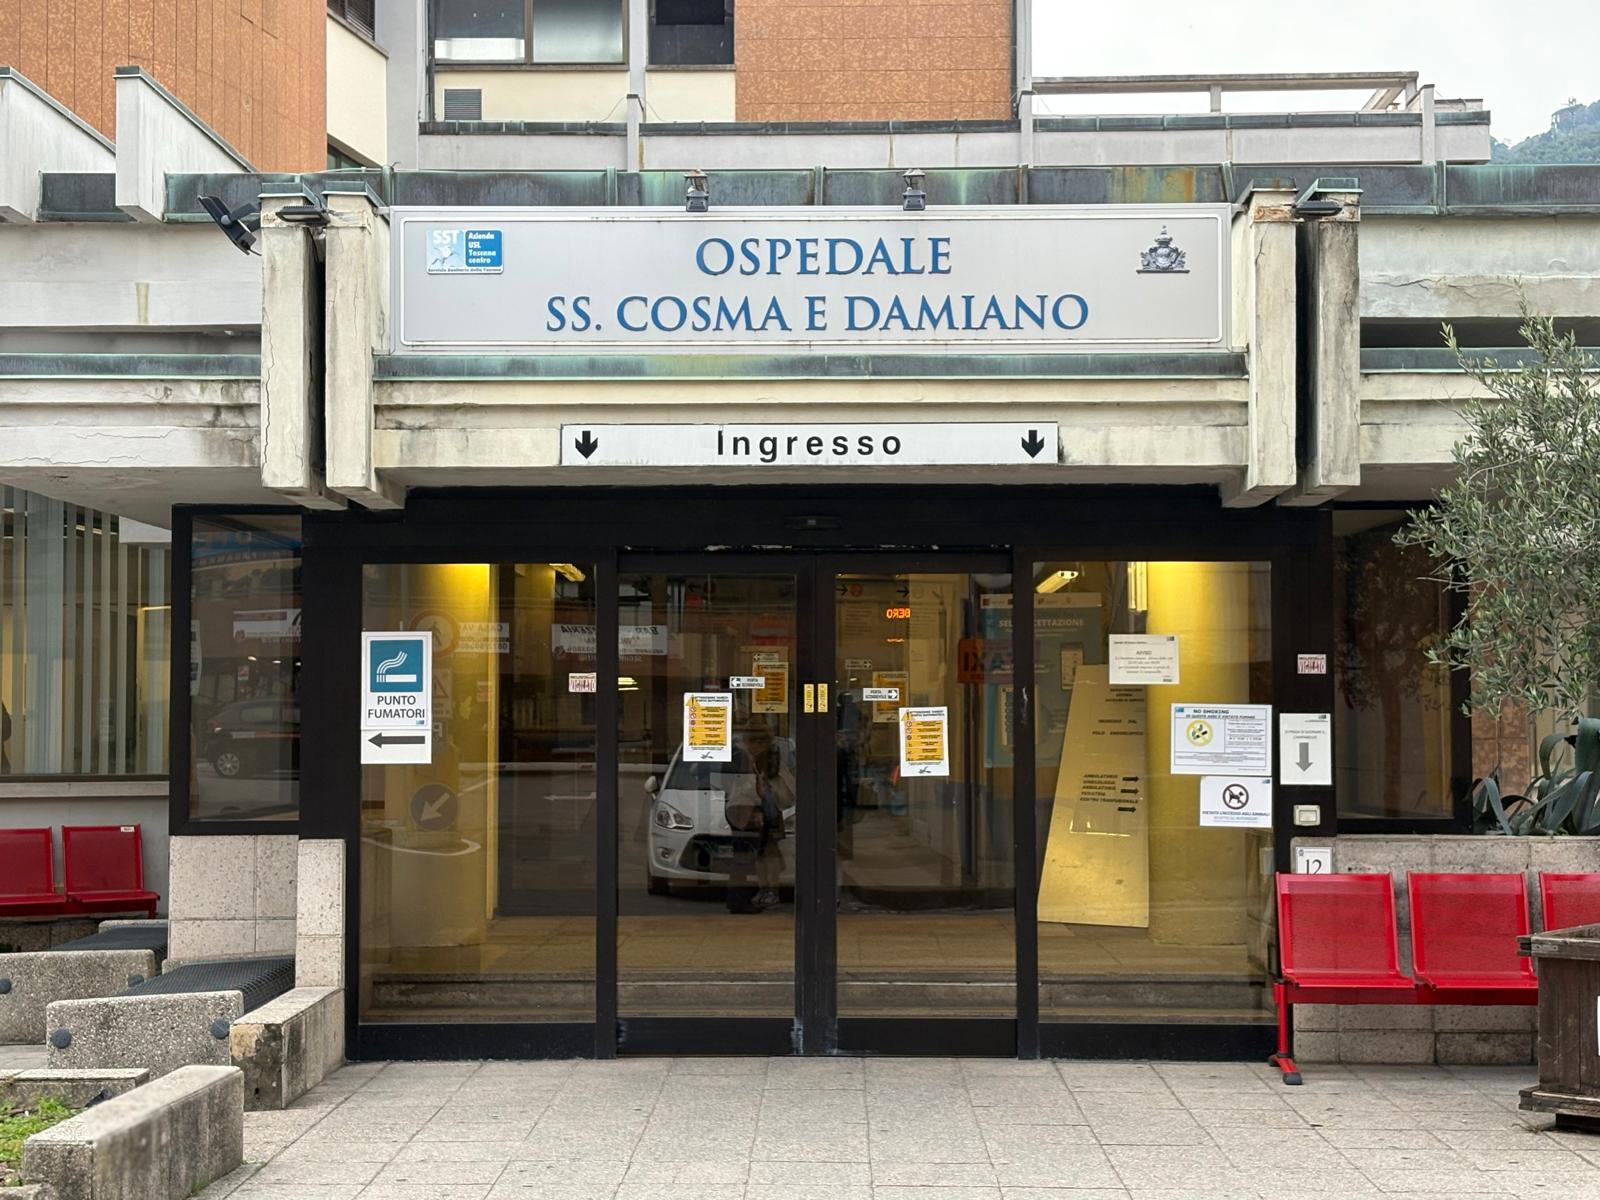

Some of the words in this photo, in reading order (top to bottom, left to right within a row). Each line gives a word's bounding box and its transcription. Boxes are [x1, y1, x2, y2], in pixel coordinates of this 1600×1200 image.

[432, 230, 459, 244] SST
[468, 232, 495, 240] Azienda
[695, 236, 953, 277] OSPEDALE
[547, 295, 602, 333] SS.
[617, 294, 792, 333] COSMA
[804, 295, 829, 332] E
[844, 293, 1089, 333] DAMIANO
[717, 430, 903, 465] Ingresso
[377, 695, 416, 706] PUNTO
[368, 708, 425, 719] FUMATORI
[1305, 859, 1323, 874] 12
